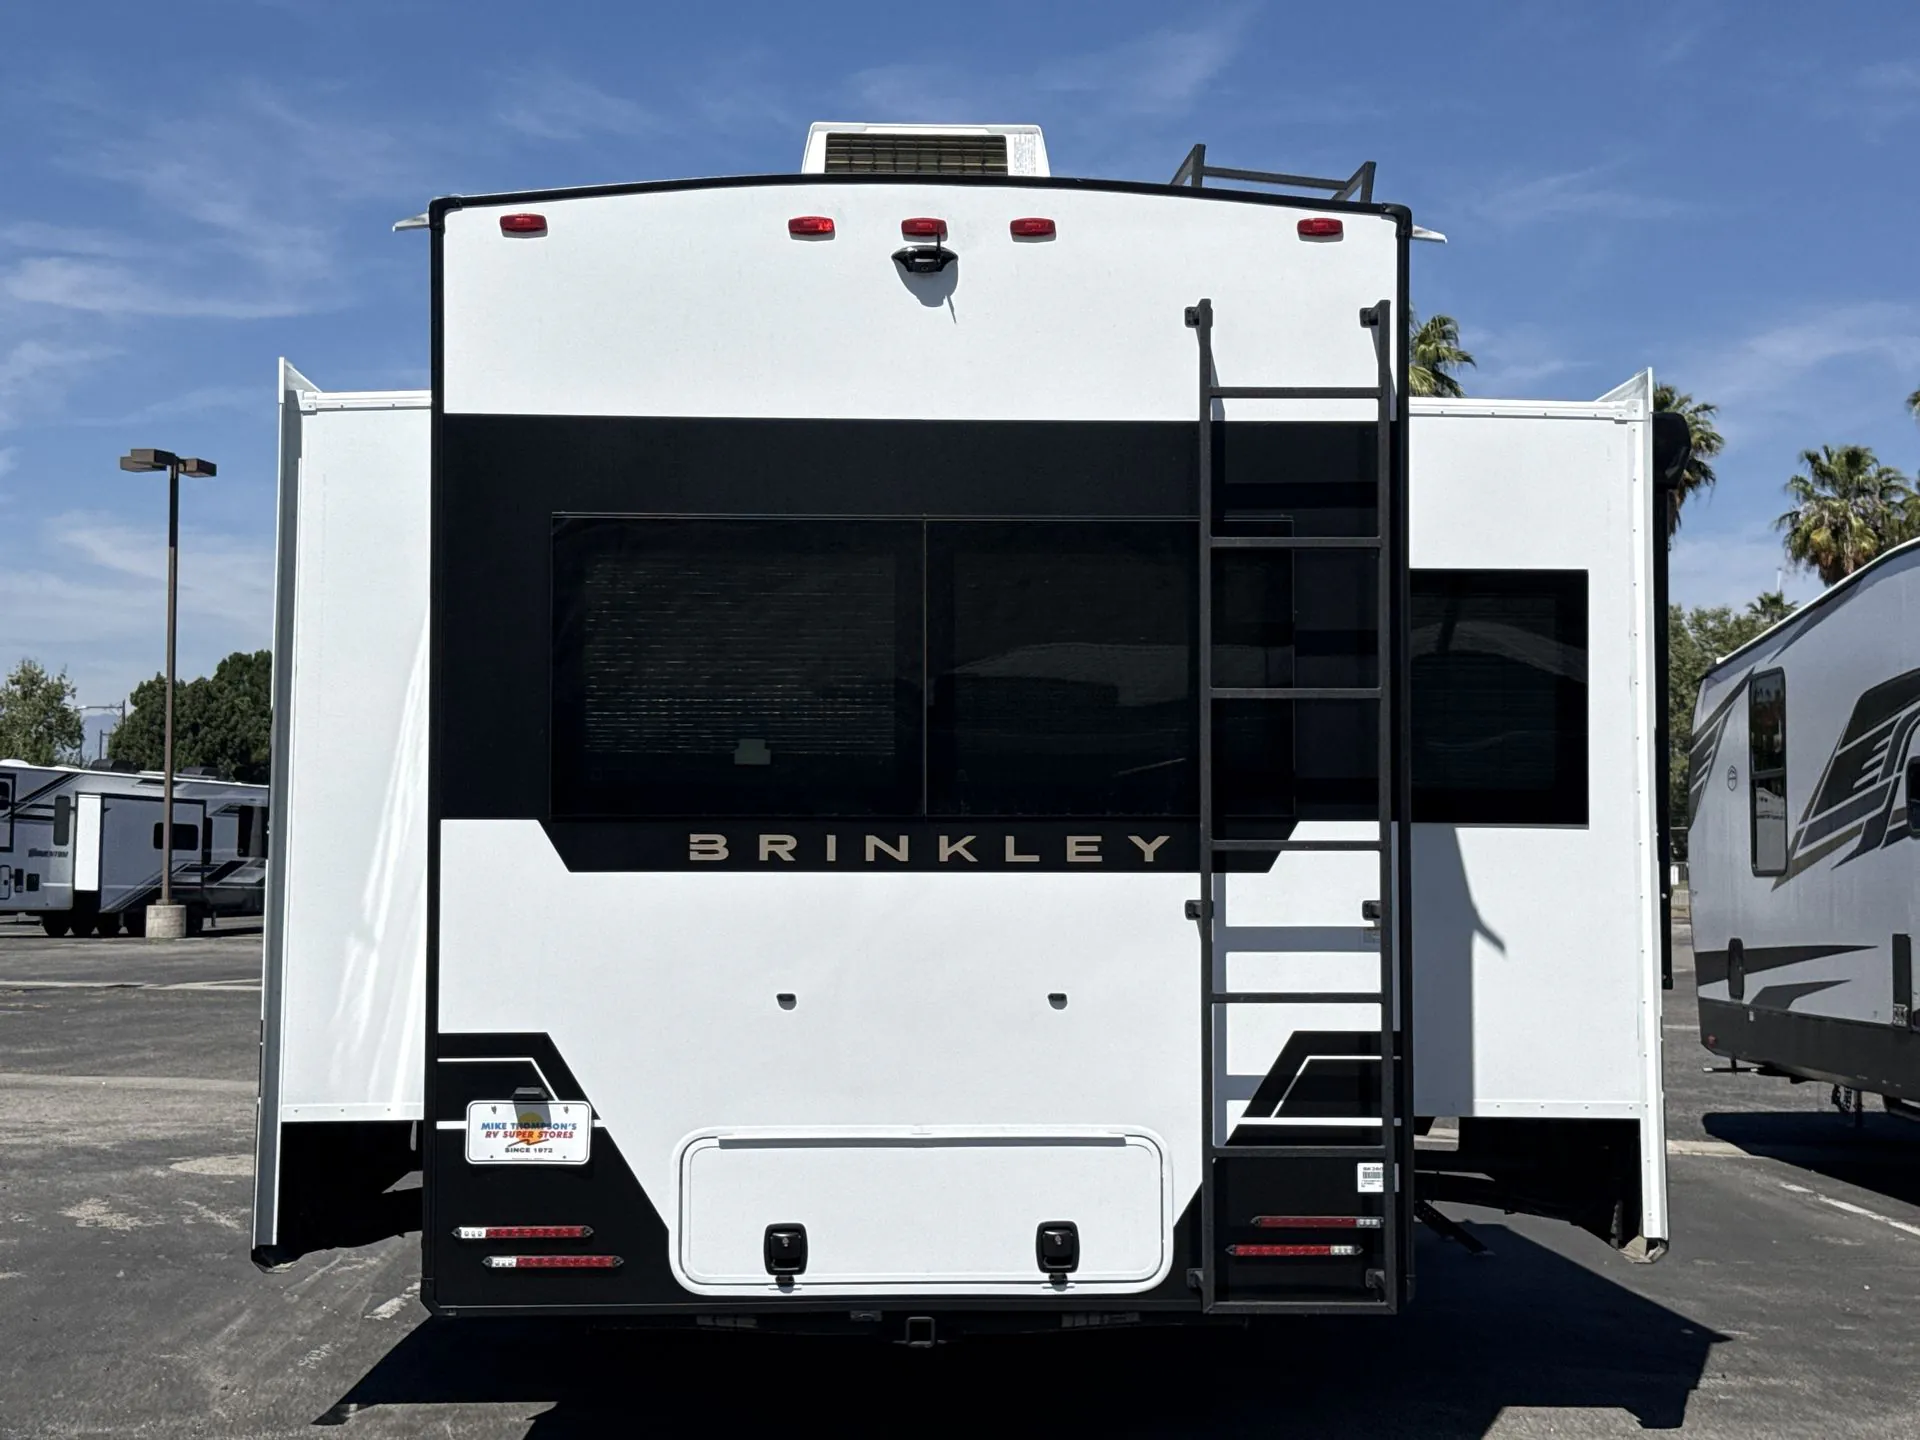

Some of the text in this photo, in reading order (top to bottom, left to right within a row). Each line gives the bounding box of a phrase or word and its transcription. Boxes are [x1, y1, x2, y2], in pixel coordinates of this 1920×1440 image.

[689, 833, 1170, 863] BRINKLEY
[481, 1122, 577, 1130] MIKE THOMPSON'S
[484, 1130, 574, 1139] RV SUPER STORES
